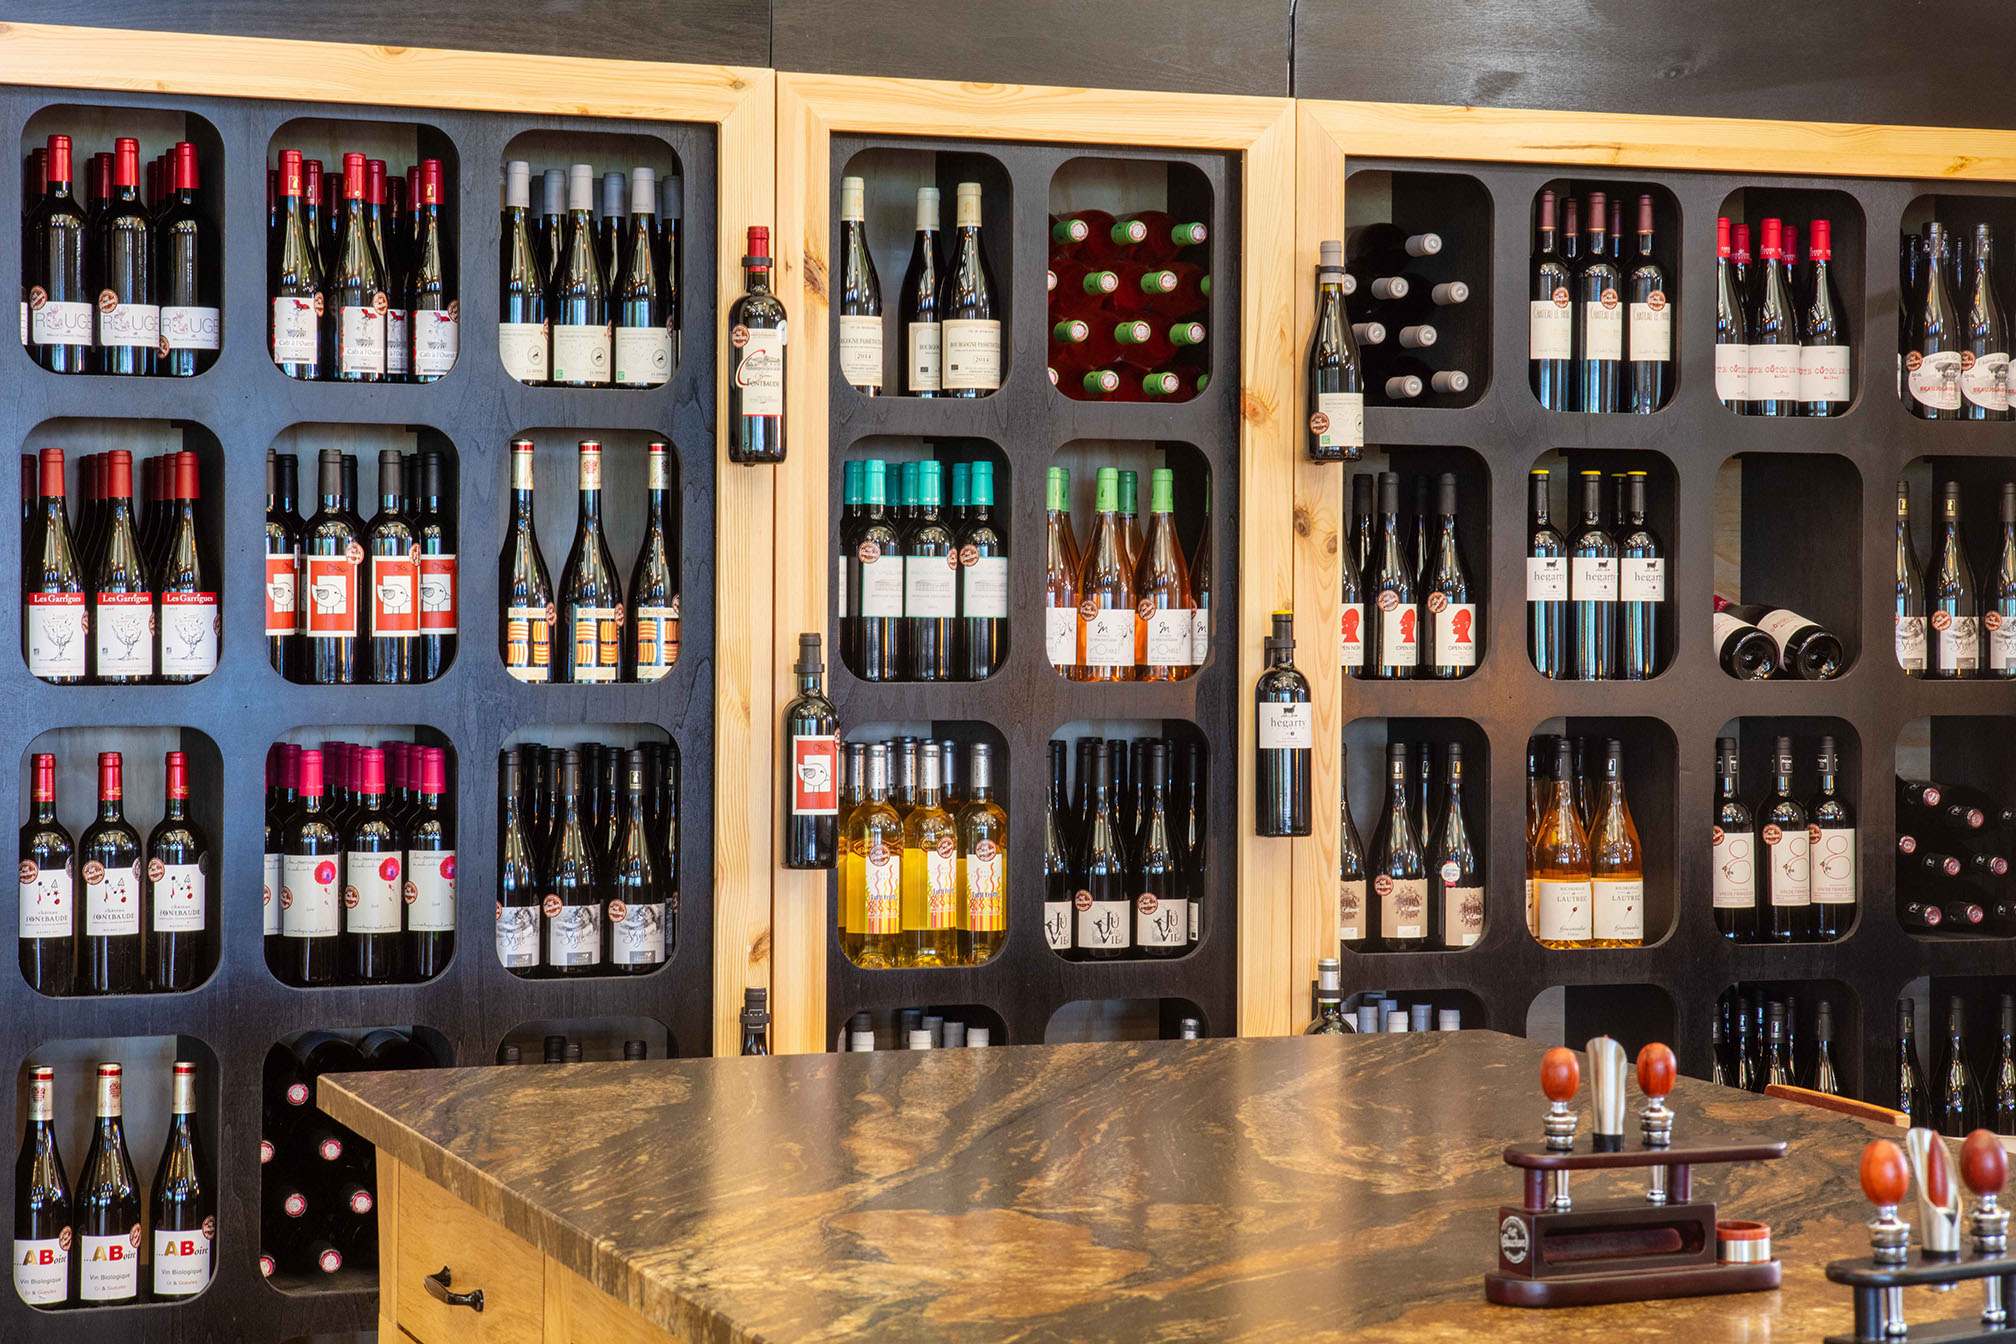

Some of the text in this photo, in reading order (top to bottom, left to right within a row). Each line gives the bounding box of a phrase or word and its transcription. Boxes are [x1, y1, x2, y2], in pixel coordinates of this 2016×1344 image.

[34, 593, 81, 605] Les Garrigues
[103, 593, 150, 605] Les Garrigues
[167, 593, 214, 605] Les Garrigues
[1271, 717, 1306, 729] hegarty
[101, 1273, 131, 1281] Biologique
[172, 1267, 202, 1276] Biologique
[32, 1277, 61, 1286] Biologique
